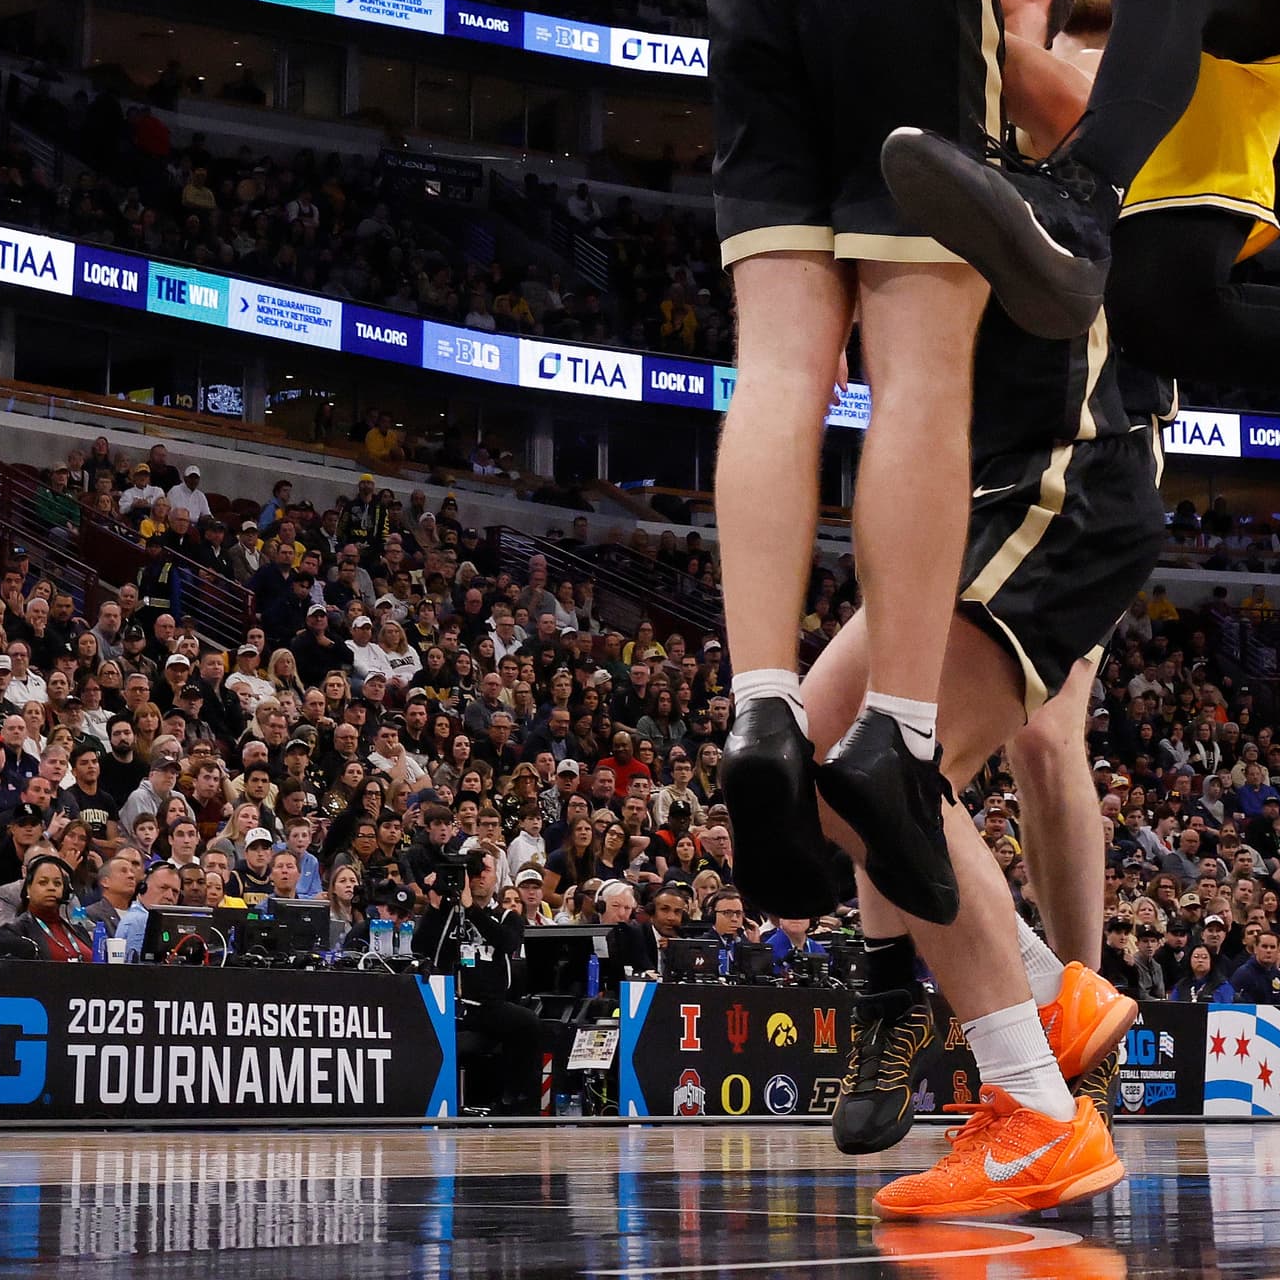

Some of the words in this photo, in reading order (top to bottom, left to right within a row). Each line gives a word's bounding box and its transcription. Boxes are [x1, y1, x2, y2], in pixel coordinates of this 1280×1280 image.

[459, 12, 509, 33] TIAA.ORG
[555, 26, 599, 53] B1G
[647, 42, 706, 69] TIAA
[83, 262, 120, 288] LOCK
[121, 270, 139, 292] IN
[156, 275, 187, 305] THE
[188, 285, 219, 311] WIN
[567, 357, 627, 391] TIAA
[651, 370, 687, 392] LOCK
[688, 375, 705, 395] IN
[67, 998, 145, 1035] 2026
[154, 1000, 217, 1036] TIAA
[227, 1002, 392, 1039] BASKETBALL
[67, 1044, 392, 1106] TOURNAMENT
[1140, 1070, 1176, 1079] TOURNAMENT
